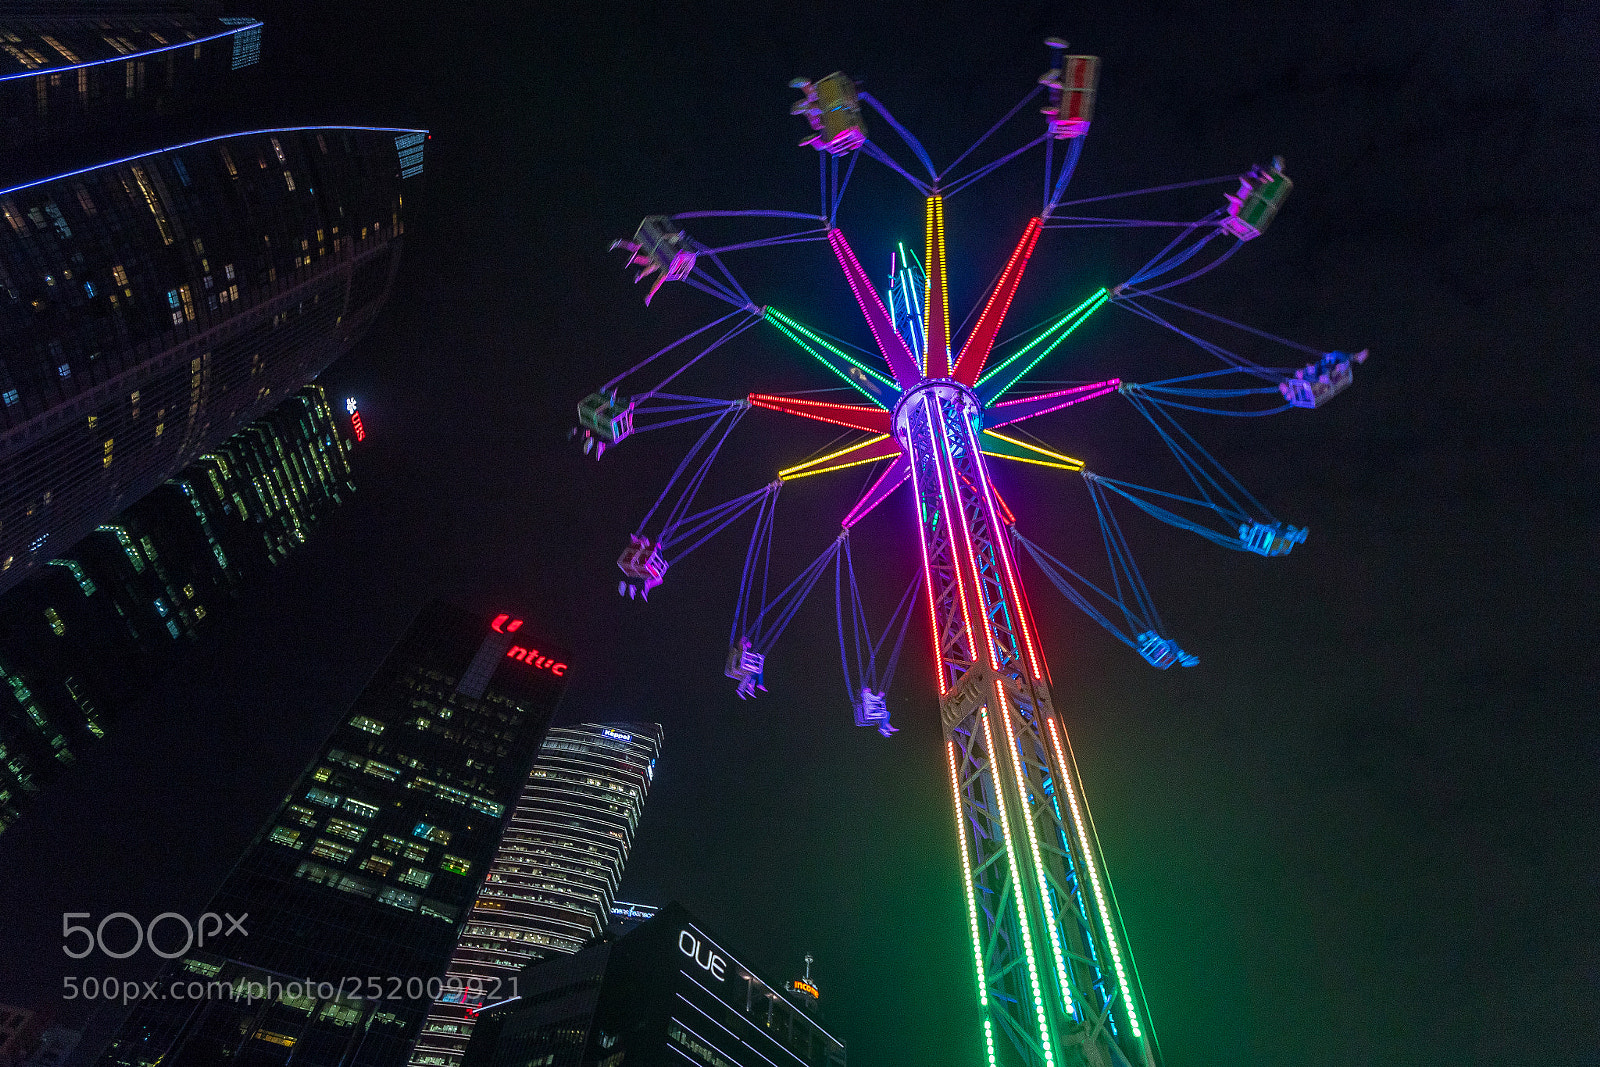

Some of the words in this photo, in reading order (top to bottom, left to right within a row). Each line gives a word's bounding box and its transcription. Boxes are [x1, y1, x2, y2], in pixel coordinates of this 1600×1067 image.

[351, 410, 366, 442] UBS
[604, 729, 631, 741] Keppel
[678, 929, 728, 982] OUE
